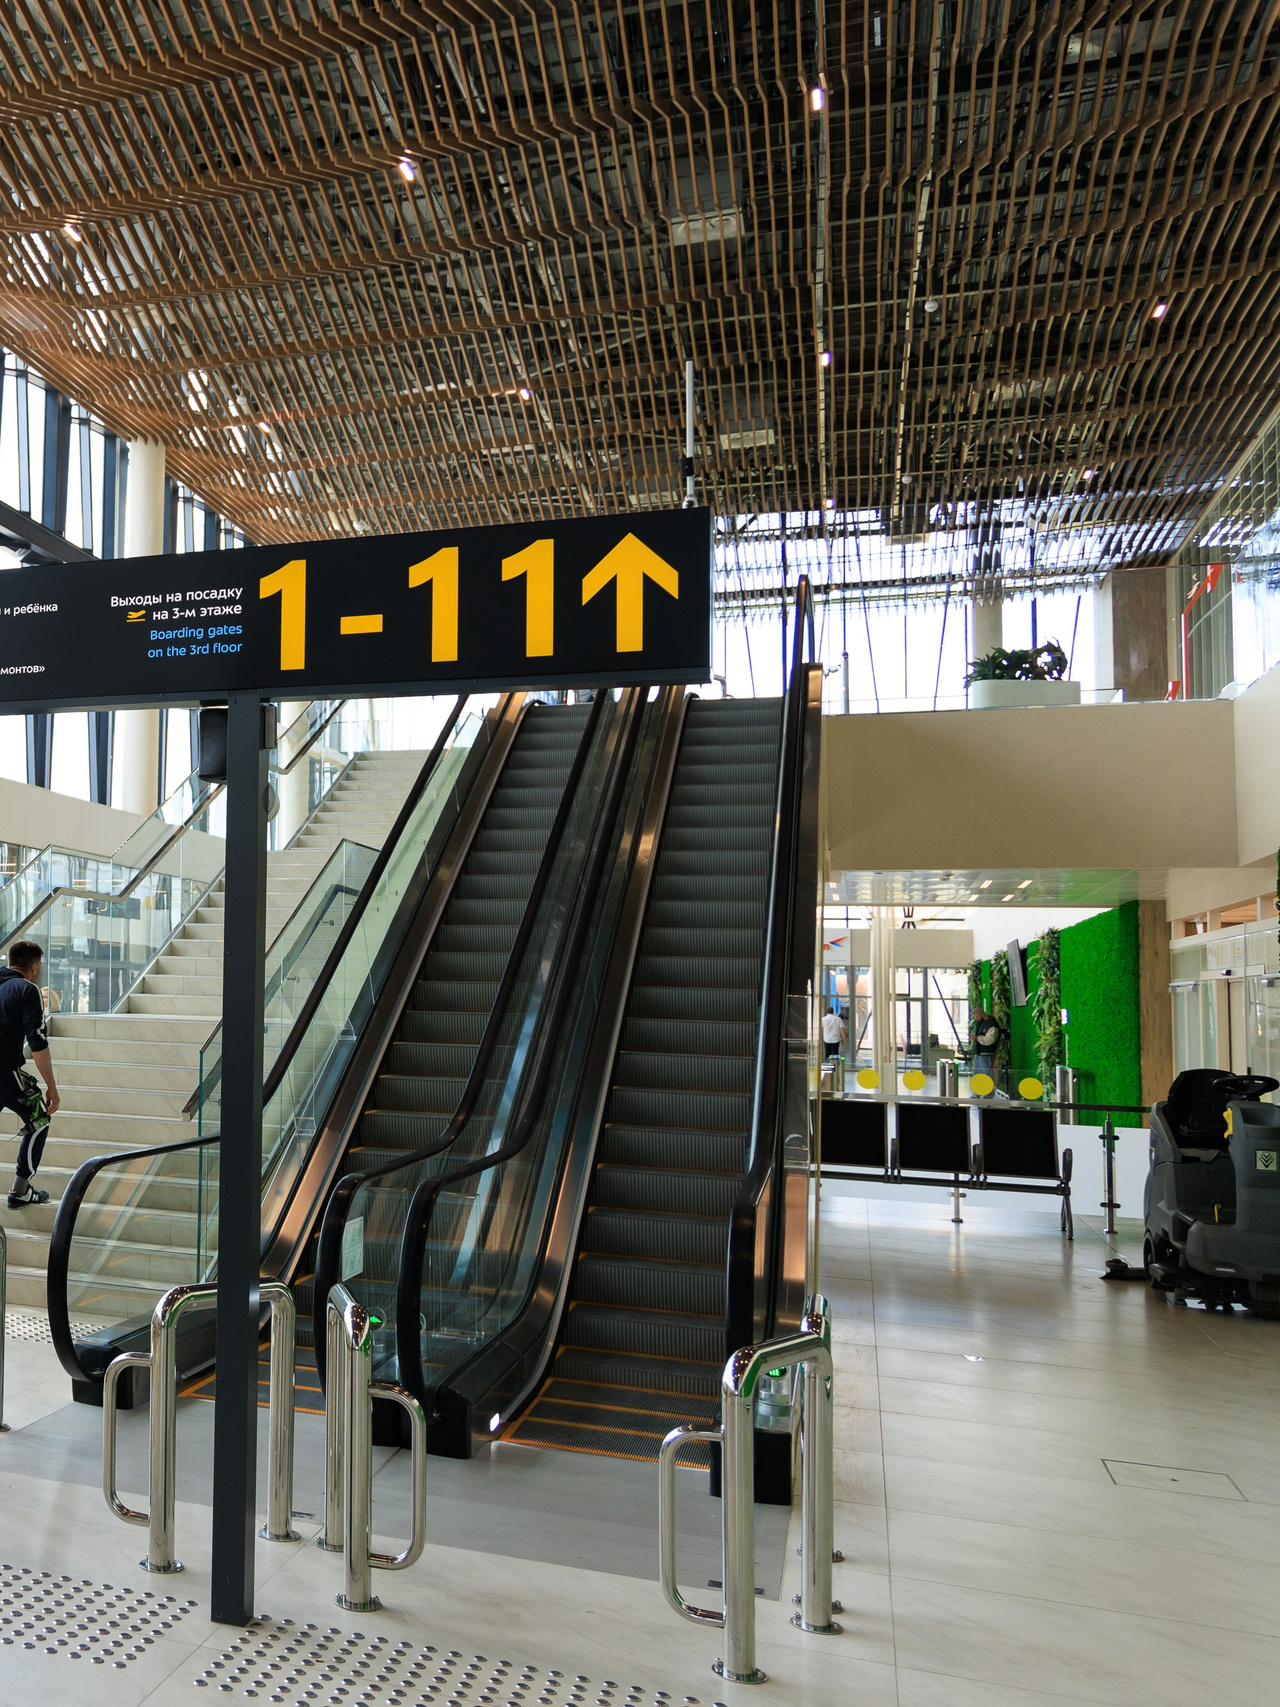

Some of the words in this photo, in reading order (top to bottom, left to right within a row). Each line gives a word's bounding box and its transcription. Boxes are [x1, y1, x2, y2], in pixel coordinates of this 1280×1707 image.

[110, 593, 162, 607] Выходы
[166, 592, 182, 603] на
[186, 587, 243, 601] посадку
[3, 607, 11, 615] и
[13, 603, 59, 617] ребёнка
[152, 610, 169, 621] на
[172, 607, 196, 619] 3-м
[199, 604, 242, 617] этаже
[150, 626, 204, 641] Boarding
[207, 624, 243, 639] gates
[147, 648, 163, 658] on
[166, 645, 187, 657] the
[189, 643, 209, 656] 3rd
[213, 642, 243, 654] floor
